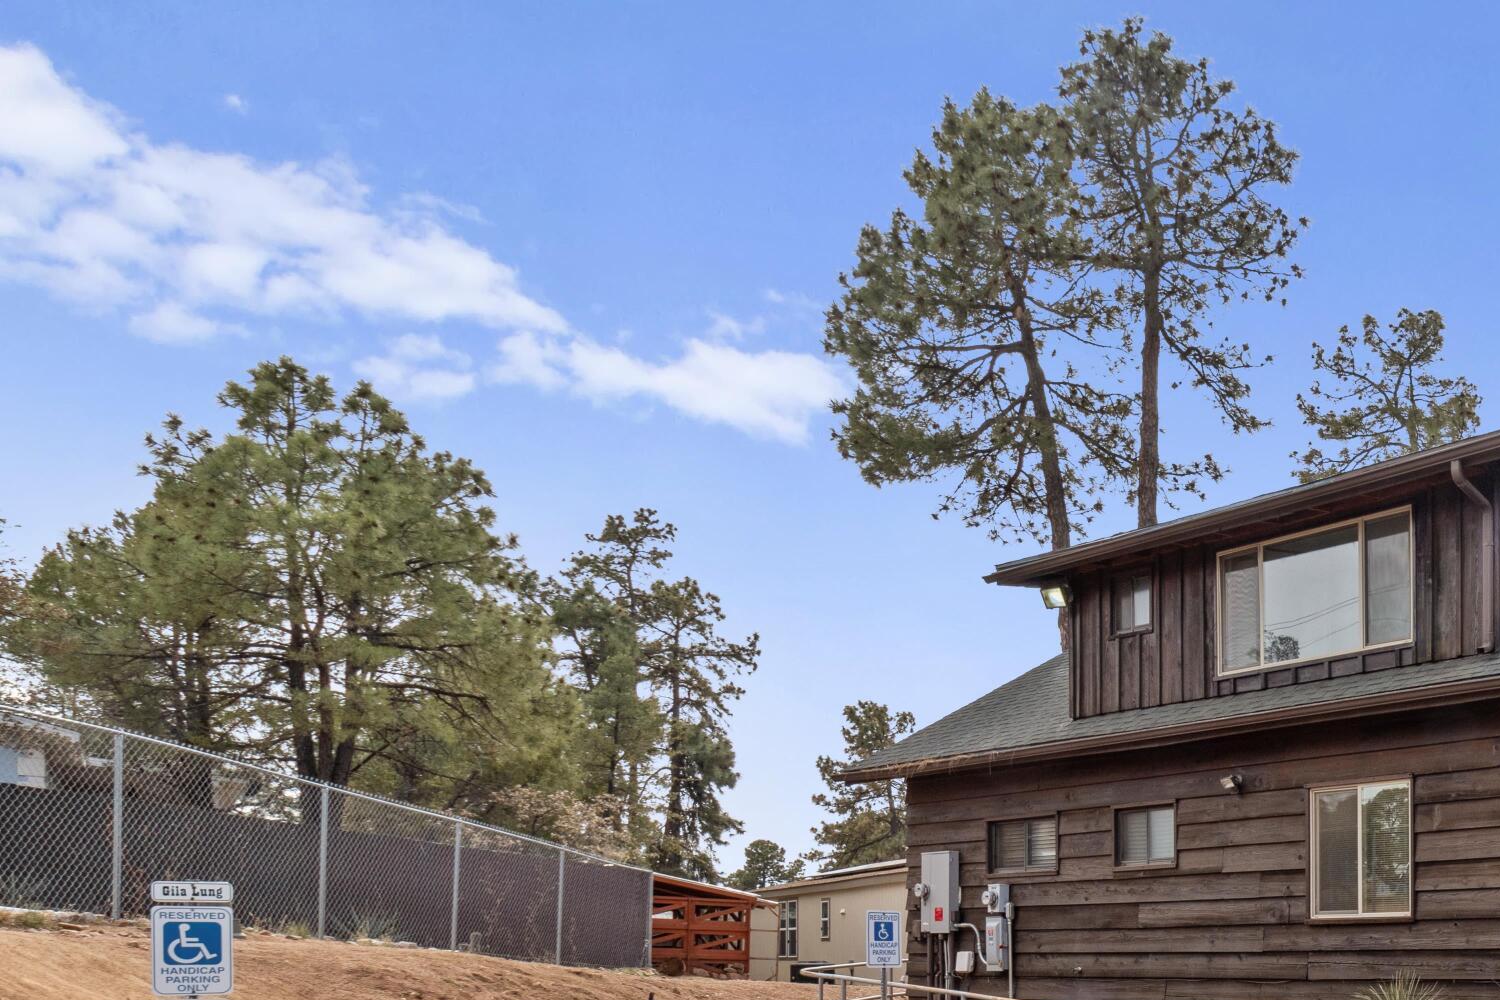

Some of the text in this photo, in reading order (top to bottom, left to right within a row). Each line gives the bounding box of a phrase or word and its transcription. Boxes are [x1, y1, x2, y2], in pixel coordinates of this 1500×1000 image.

[162, 886, 223, 899] Gila Lung
[159, 911, 226, 920] RESERVED
[160, 967, 225, 975] HANDICAP
[165, 975, 221, 984] PARKING
[177, 984, 209, 992] ONLY
